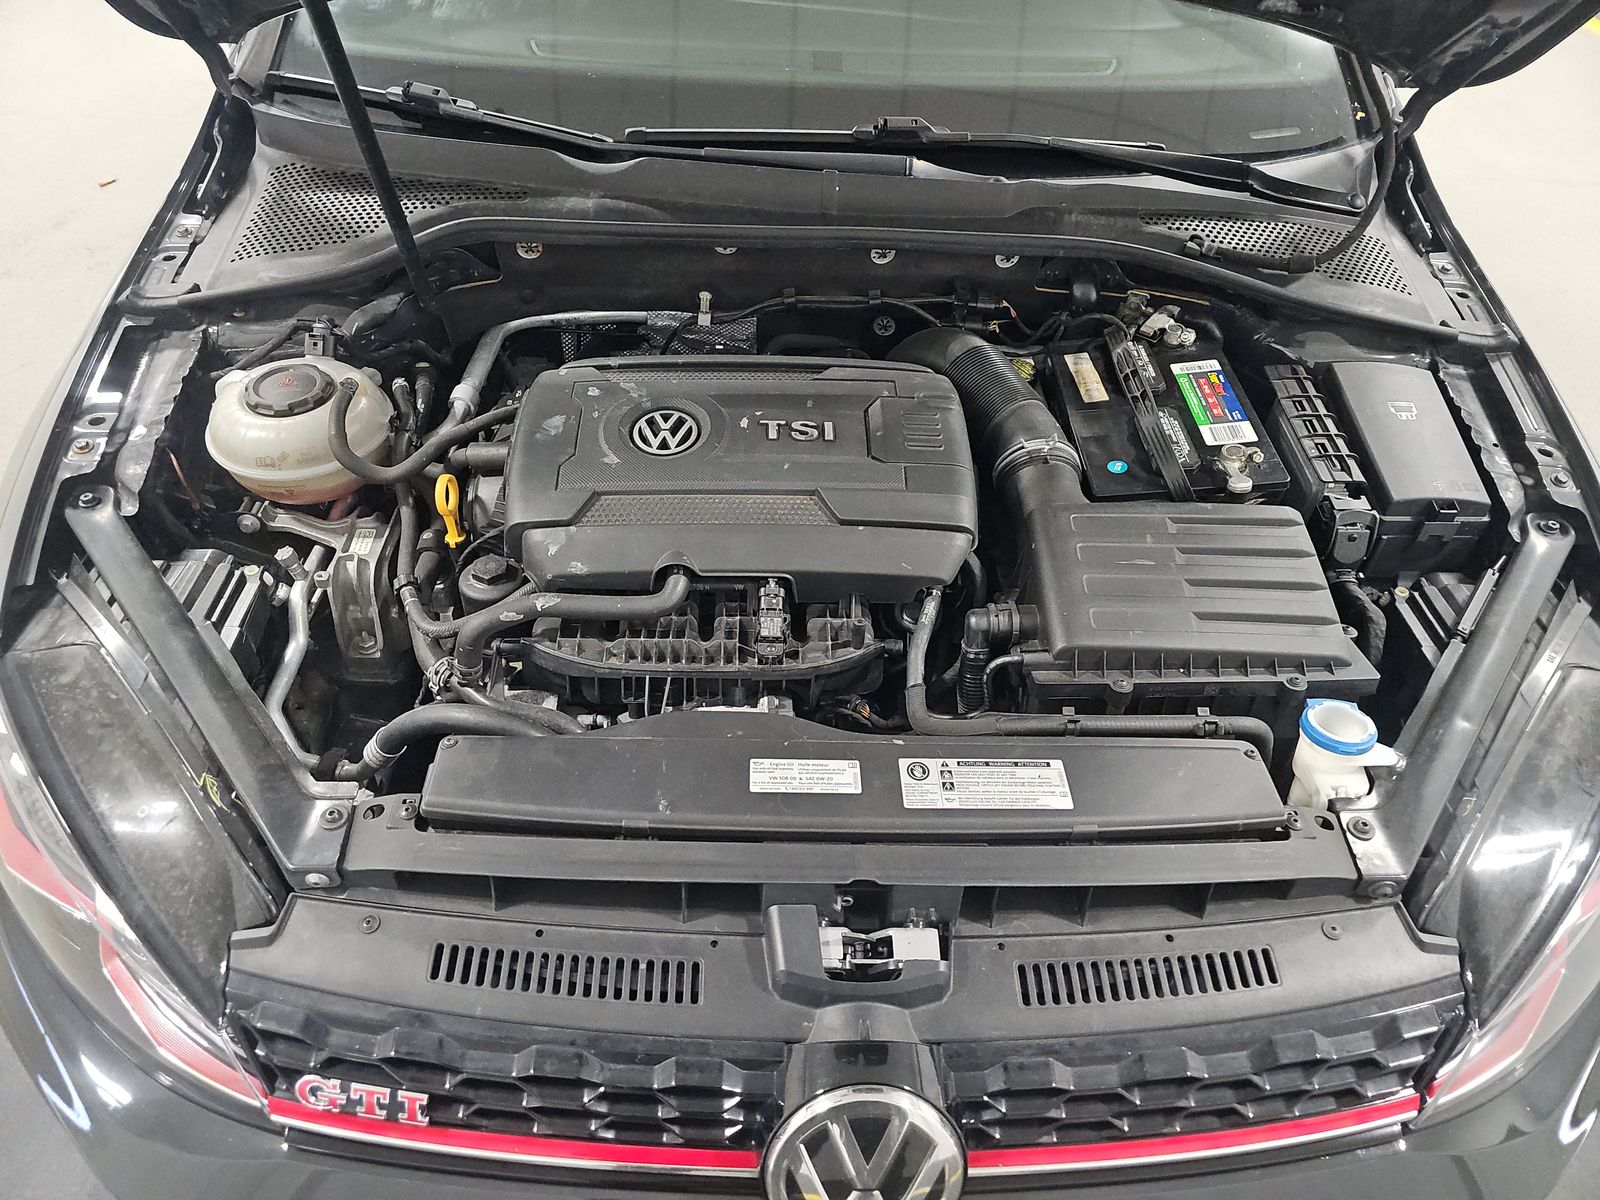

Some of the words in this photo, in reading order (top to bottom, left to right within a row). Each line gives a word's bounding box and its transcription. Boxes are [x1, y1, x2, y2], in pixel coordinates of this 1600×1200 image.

[633, 410, 698, 455] VW
[759, 420, 836, 442] TSI
[294, 1073, 430, 1127] GTI
